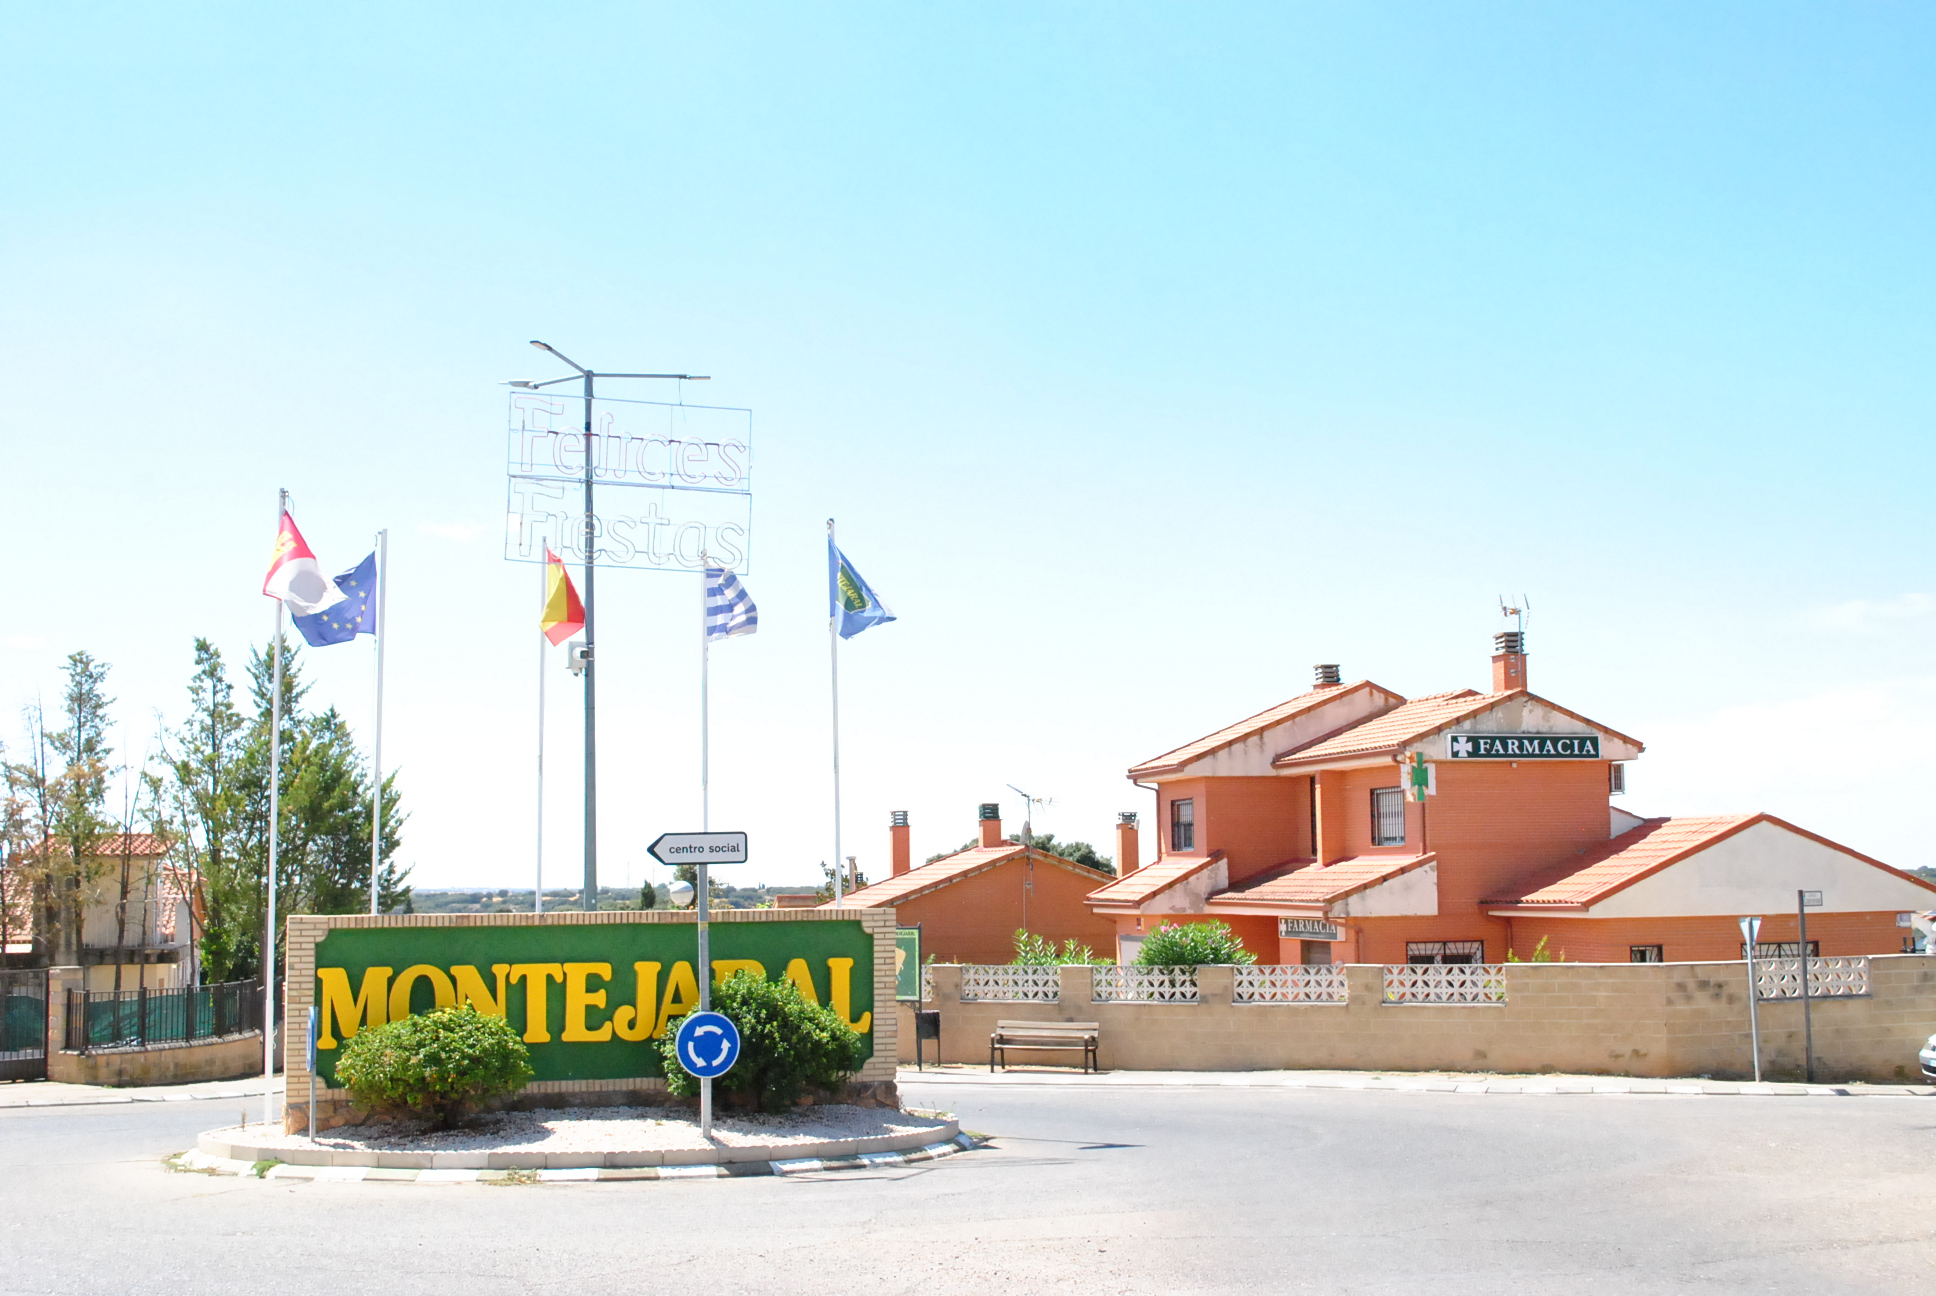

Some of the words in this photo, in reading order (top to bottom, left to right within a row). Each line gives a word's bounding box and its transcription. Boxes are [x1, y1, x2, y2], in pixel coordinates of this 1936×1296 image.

[514, 396, 747, 487] Felices
[514, 481, 745, 570] Fiestas
[1478, 739, 1597, 755] FARMACIA
[668, 844, 705, 854] centro
[708, 843, 741, 853] social
[1287, 918, 1337, 934] FARMACIA
